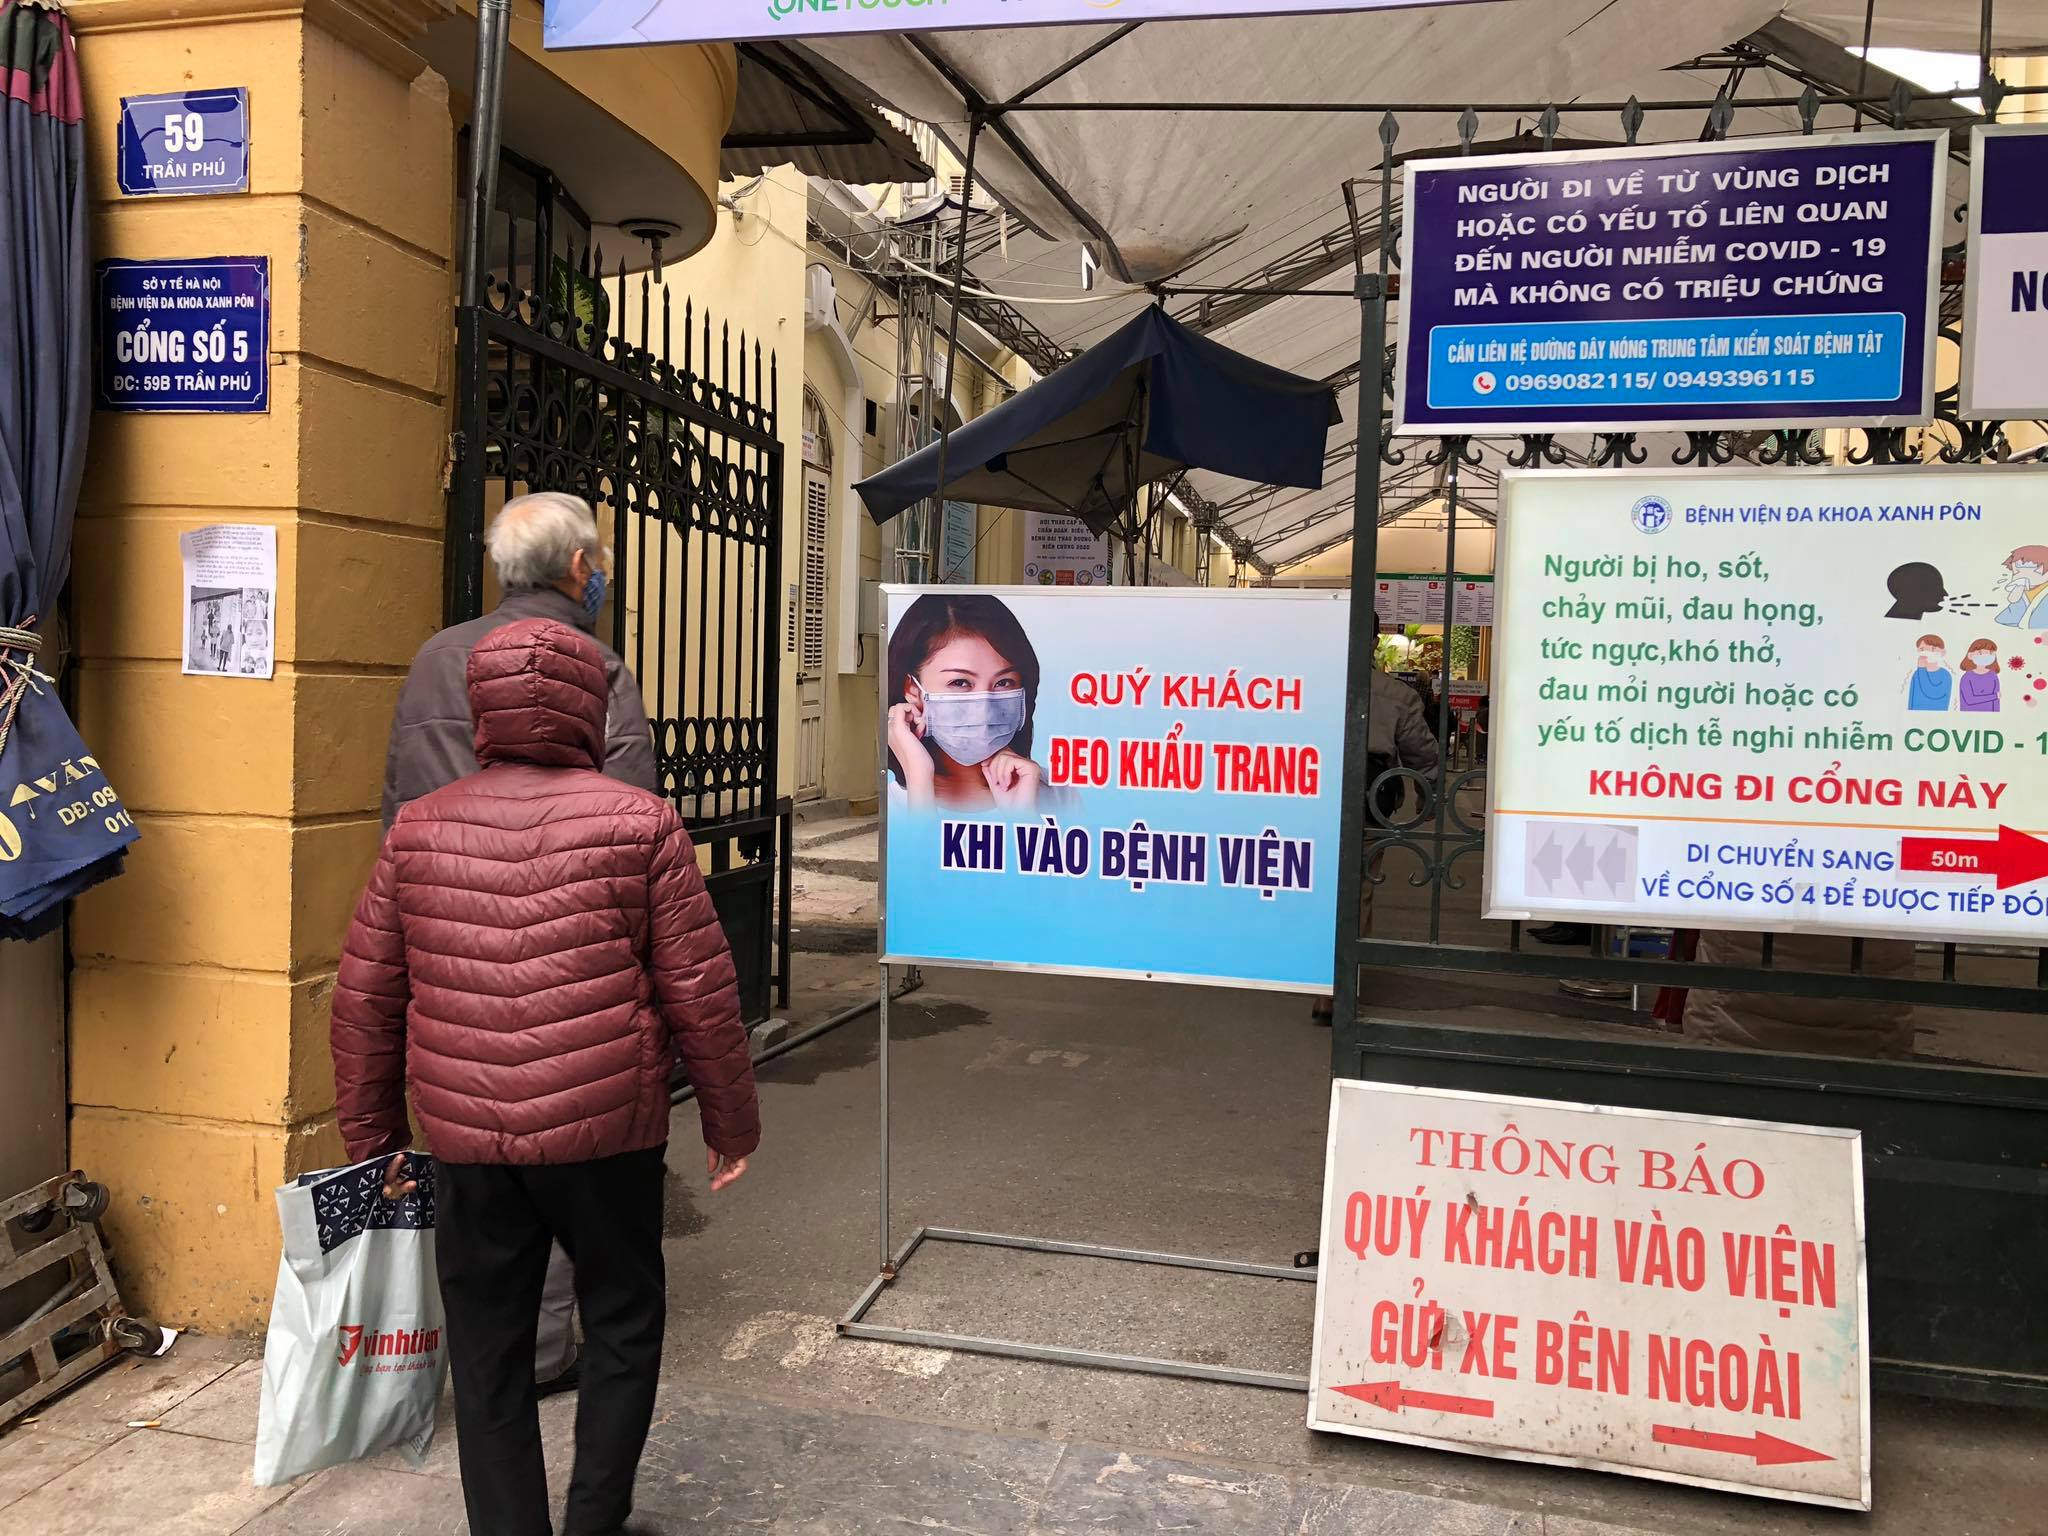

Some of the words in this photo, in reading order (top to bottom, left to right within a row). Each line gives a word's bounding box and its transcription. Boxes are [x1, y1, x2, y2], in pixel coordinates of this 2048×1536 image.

[164, 112, 203, 153] 59
[142, 157, 187, 179] TRẦN
[192, 157, 225, 177] PHÚ
[1458, 177, 1548, 203] NGƯỜI
[1561, 179, 1592, 198] ĐI
[1606, 168, 1646, 196] VỀ
[1657, 168, 1700, 193] TỪ
[1712, 166, 1799, 191] VÙNG
[1816, 163, 1889, 190] DỊCH
[1456, 212, 1536, 241] HOẶC
[1546, 209, 1588, 234] CÓ
[1598, 204, 1657, 231] YẾU
[1667, 200, 1709, 228] TỐ
[1719, 201, 1785, 226] LIÊN
[1796, 200, 1888, 223] QUAN
[1454, 245, 1512, 272] ĐẾN
[1521, 243, 1613, 269] NGƯỜI
[1622, 235, 1716, 265] NHIỄM
[1725, 240, 1821, 262] COVID
[1852, 237, 1886, 257] 19
[142, 276, 158, 290] SỞ
[160, 279, 167, 290] Y
[169, 275, 183, 290] TẾ
[185, 277, 200, 290] HÀ
[202, 276, 221, 291] NỘI
[1454, 282, 1499, 306] MÀ
[1510, 280, 1611, 304] KHÔNG
[1622, 276, 1664, 301] CÓ
[1674, 273, 1761, 303] TRIỆU
[1773, 270, 1884, 296] CHỨNG
[2011, 270, 2048, 312] N
[110, 294, 135, 312] BỆNH
[136, 294, 159, 312] VIỆN
[160, 297, 175, 309] ĐA
[177, 296, 204, 309] KHOA
[206, 296, 233, 309] XANH
[234, 293, 254, 308] PÔN
[116, 318, 185, 363] CỔNG
[192, 318, 226, 363] SỐ
[233, 330, 248, 363] 5
[1478, 339, 1507, 363] LIÊN
[1510, 338, 1528, 365] HỆ
[1530, 336, 1576, 361] ĐƯỜNG
[1579, 337, 1606, 360] DÂY
[1609, 335, 1648, 359] NÓNG
[1651, 337, 1696, 359] TRUNG
[1700, 333, 1730, 357] TÂM
[1733, 328, 1769, 356] KIỂM
[1774, 331, 1811, 356] SOÁT
[1813, 330, 1853, 359] BỆNH
[1857, 329, 1884, 358] TẬT
[113, 375, 140, 391] ĐC:
[143, 375, 171, 391] 59B
[175, 369, 216, 391] TRẦN
[220, 371, 251, 391] PHÚ
[1505, 371, 1657, 391] 0969082115/
[1662, 368, 1815, 388] 0949396115
[1685, 504, 1734, 525] BỆNH
[1739, 503, 1782, 525] VIỆN
[1786, 507, 1813, 523] ĐA
[1818, 506, 1873, 522] KHOA
[1877, 505, 1934, 522] XANH
[1939, 501, 1982, 521] PÔN
[1544, 554, 1623, 583] Người
[1632, 555, 1657, 584] bị
[1666, 555, 1708, 582] ho,
[1717, 551, 1770, 583] sốt,
[1541, 592, 1606, 624] chảy
[1615, 596, 1673, 624] mũi,
[1682, 594, 1733, 621] đau
[1743, 597, 1824, 627] họng,
[1540, 636, 1583, 660] tức
[1728, 635, 1782, 667] thở,
[1070, 667, 1151, 707] QUÝ
[1163, 669, 1301, 711] KHÁCH
[1538, 676, 1588, 702] đau
[1597, 674, 1647, 703] mỏi
[1656, 680, 1735, 709] người
[1745, 682, 1814, 712] hoặc
[1823, 684, 1859, 707] có
[1537, 715, 1585, 747] yếu
[1594, 717, 1624, 744] tố
[1630, 721, 1687, 750] dịch
[1697, 717, 1723, 747] tễ
[1732, 725, 1793, 753] nghi
[1804, 720, 1894, 752] nhiễm
[1904, 728, 2004, 753] COVID
[1050, 737, 1109, 786] ĐEO
[1119, 722, 1203, 791] KHẨU
[1213, 743, 1319, 796] TRANG
[1589, 764, 1723, 800] KHÔNG
[1734, 774, 1774, 802] ĐI
[1787, 760, 1903, 806] CỔNG
[1917, 774, 2008, 810] NÀY
[57, 801, 95, 826] DĐ:
[942, 822, 1003, 871] KHI
[1016, 817, 1089, 876] VÀO
[1102, 821, 1206, 889] BỆNH
[1219, 828, 1311, 898] VIỆN
[1687, 843, 1709, 863] DI
[1717, 838, 1814, 868] CHUYỂN
[1822, 849, 1895, 871] SANG
[1931, 850, 1979, 868] 50m
[1642, 869, 1671, 897] VỀ
[1677, 870, 1754, 900] CỔNG
[1761, 877, 1794, 905] SỐ
[1801, 886, 1816, 905] 4
[1823, 877, 1857, 906] ĐỂ
[1863, 886, 1940, 914] ĐƯỢC
[1948, 885, 1995, 913] TIẾP
[2002, 889, 2048, 917] ĐÓ
[1409, 1124, 1620, 1185] THÔNG
[1638, 1142, 1765, 1200] BÁO
[1343, 1185, 1431, 1261] QUÝ
[1443, 1195, 1598, 1279] KHÁCH
[1614, 1210, 1705, 1292] VÀO
[1722, 1224, 1837, 1318] VIỆN
[1370, 1276, 1446, 1371] GỬI
[1459, 1310, 1518, 1381] XE
[1535, 1310, 1630, 1396] BÊN
[1648, 1334, 1802, 1421] NGOÀI
